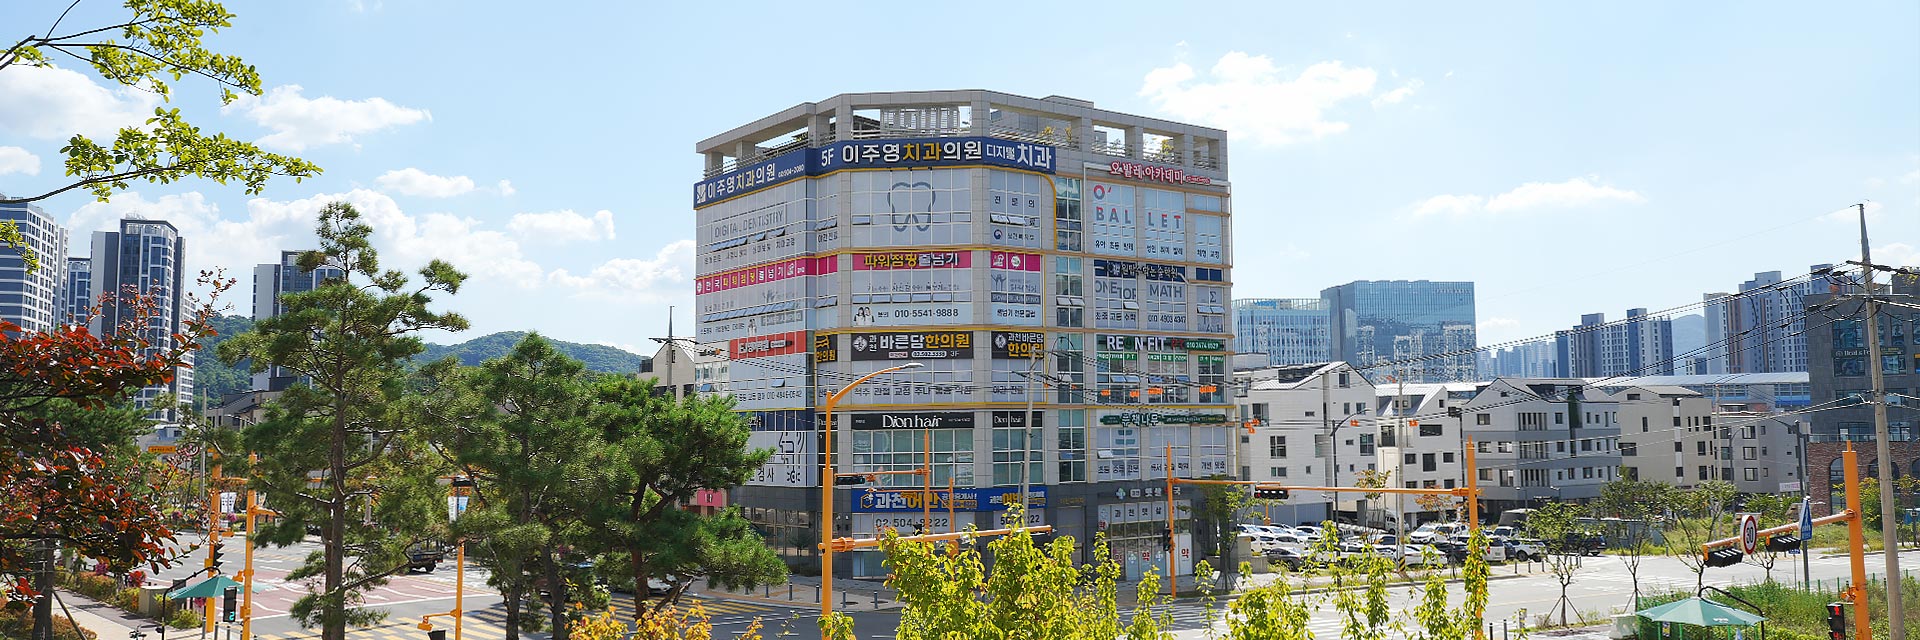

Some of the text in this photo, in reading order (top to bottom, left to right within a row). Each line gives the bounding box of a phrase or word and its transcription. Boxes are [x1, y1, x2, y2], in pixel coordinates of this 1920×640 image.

[820, 141, 1052, 169] 5F 이주영치과의원 디지털 치과
[707, 163, 776, 199] 이주영치과의원
[1149, 284, 1183, 299] MATH
[879, 333, 970, 349] 바른담한의원
[1147, 337, 1168, 351] FIT
[882, 414, 914, 428] Dion
[914, 414, 942, 428] hair
[749, 467, 775, 482] 검사
[1746, 526, 1754, 544] 30
